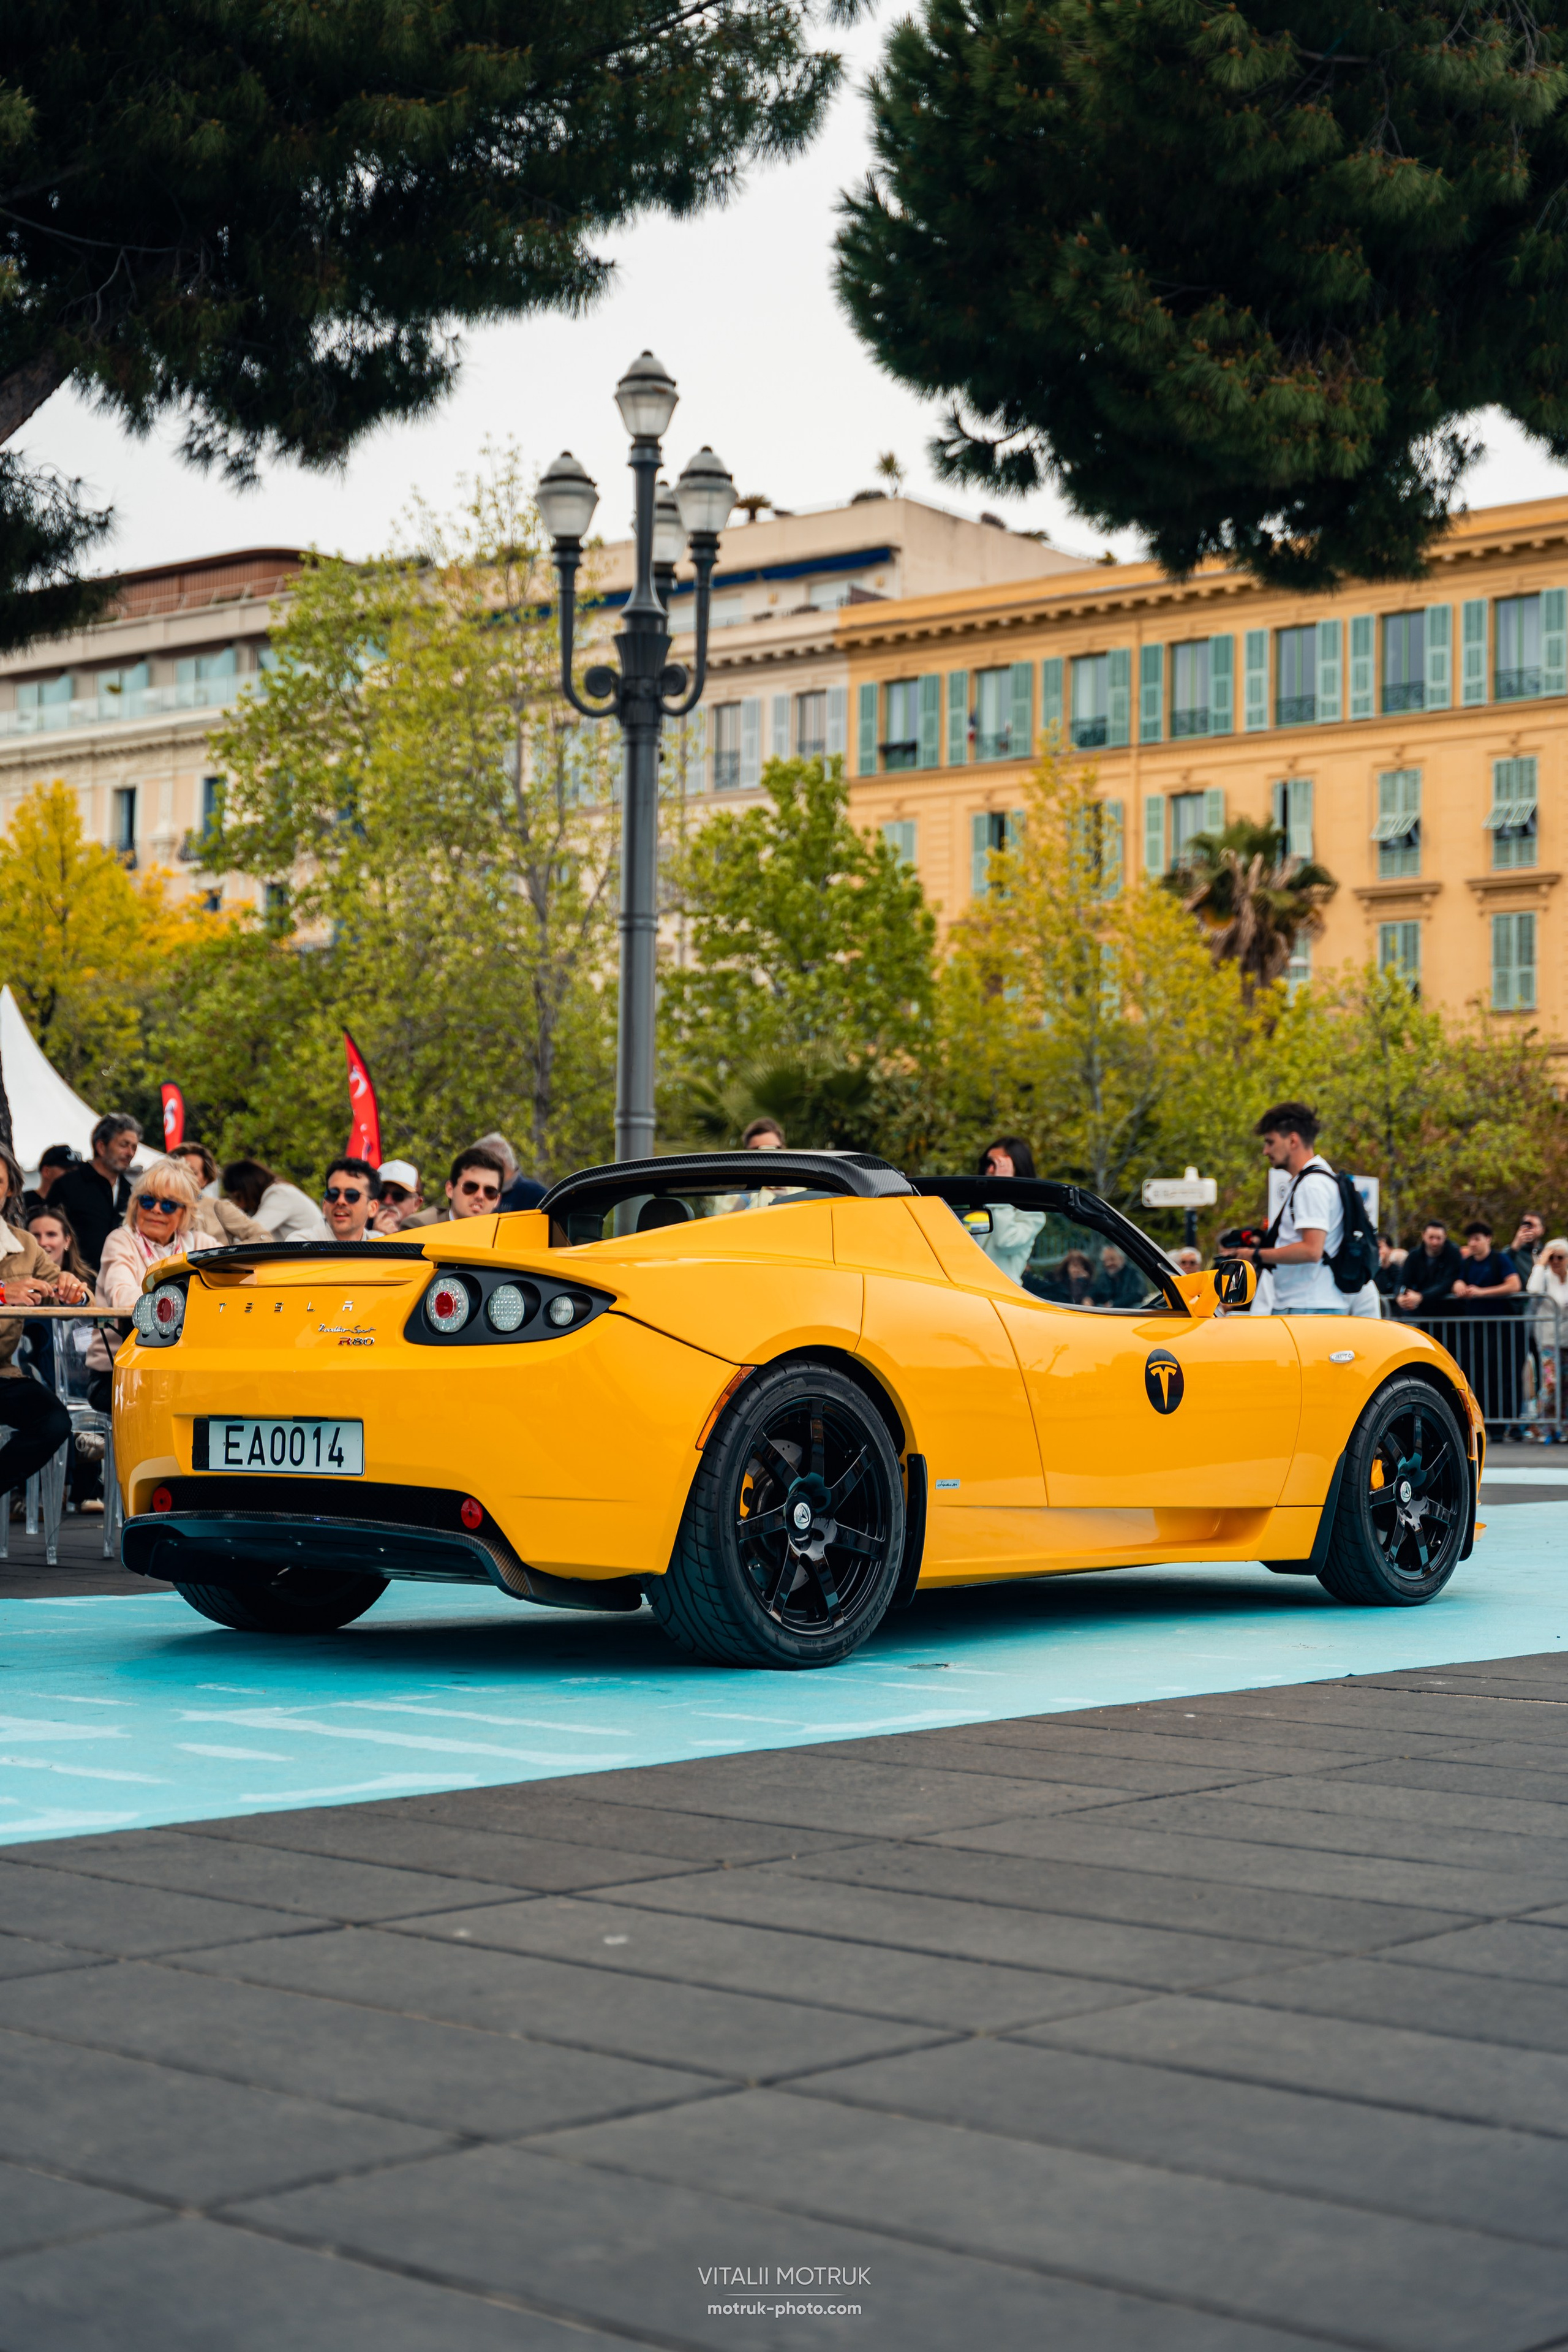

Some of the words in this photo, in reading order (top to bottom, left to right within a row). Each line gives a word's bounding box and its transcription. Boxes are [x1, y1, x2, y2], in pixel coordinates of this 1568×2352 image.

[219, 1301, 353, 1313] TESLA
[338, 1336, 375, 1346] R80
[224, 1425, 344, 1468] EA0014
